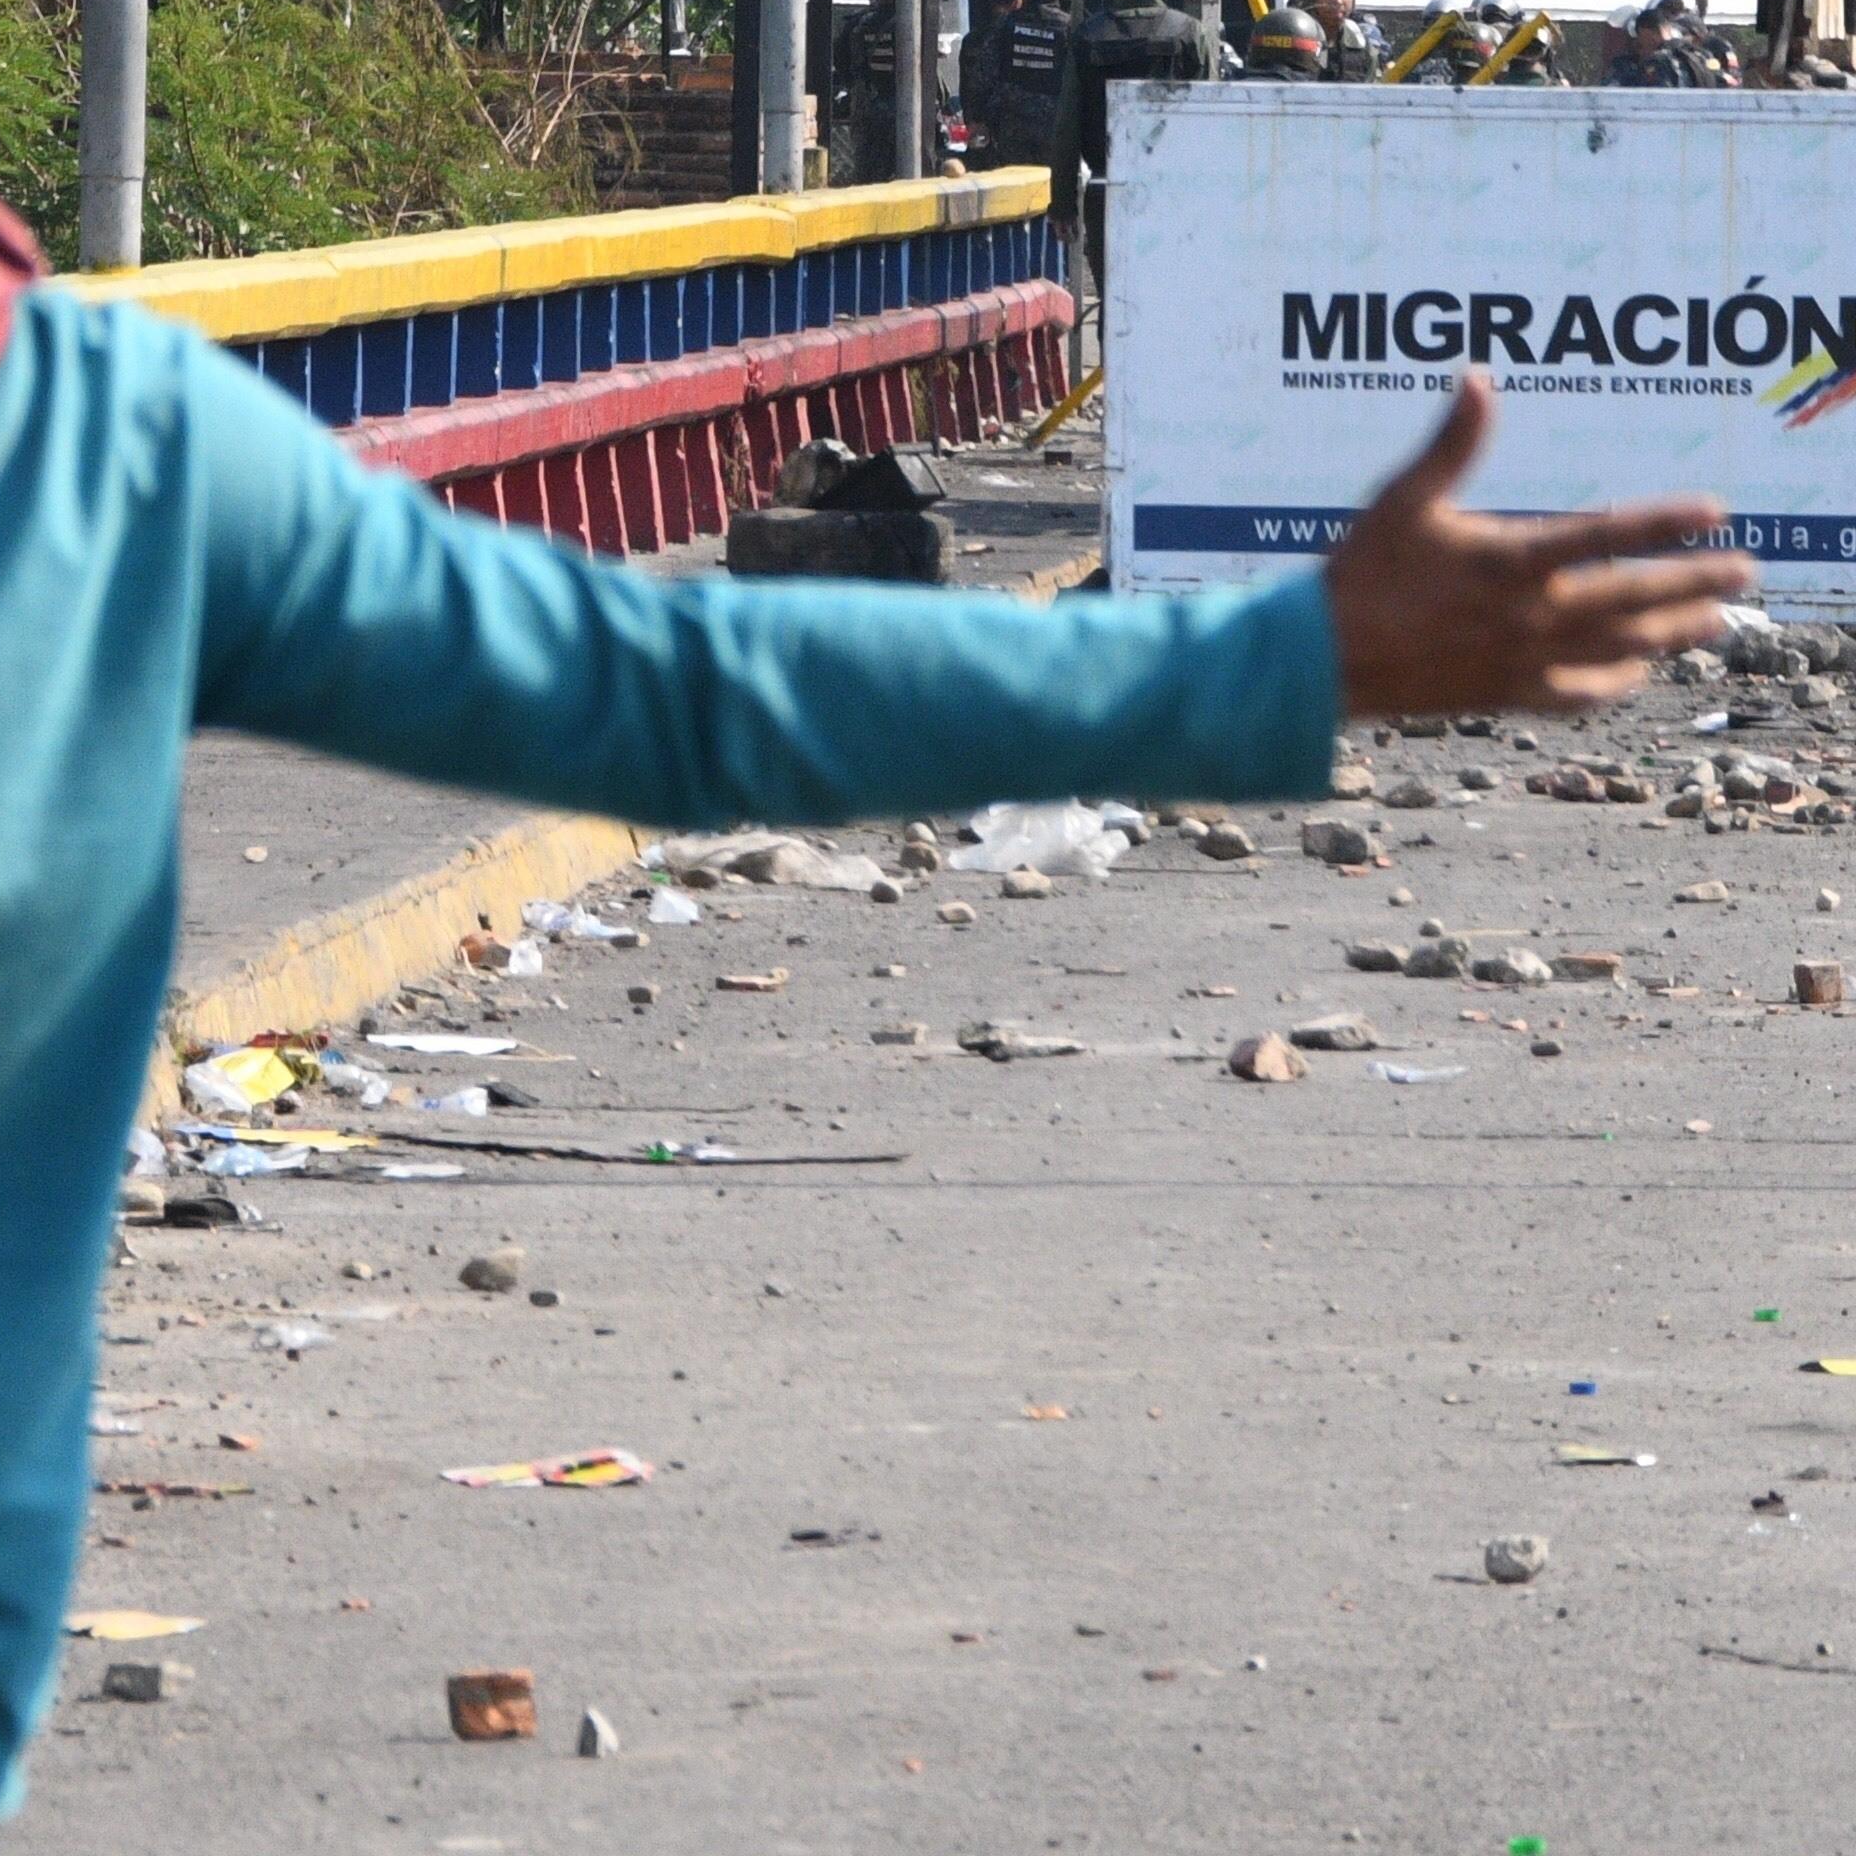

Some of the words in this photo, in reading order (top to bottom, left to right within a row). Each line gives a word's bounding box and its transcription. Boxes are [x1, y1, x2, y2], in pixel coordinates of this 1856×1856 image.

[1282, 371, 1416, 392] MINISTERIO
[1423, 373, 1455, 393] DE
[1462, 373, 1603, 395] LACIONES
[1610, 375, 1753, 397] EXTERIORES
